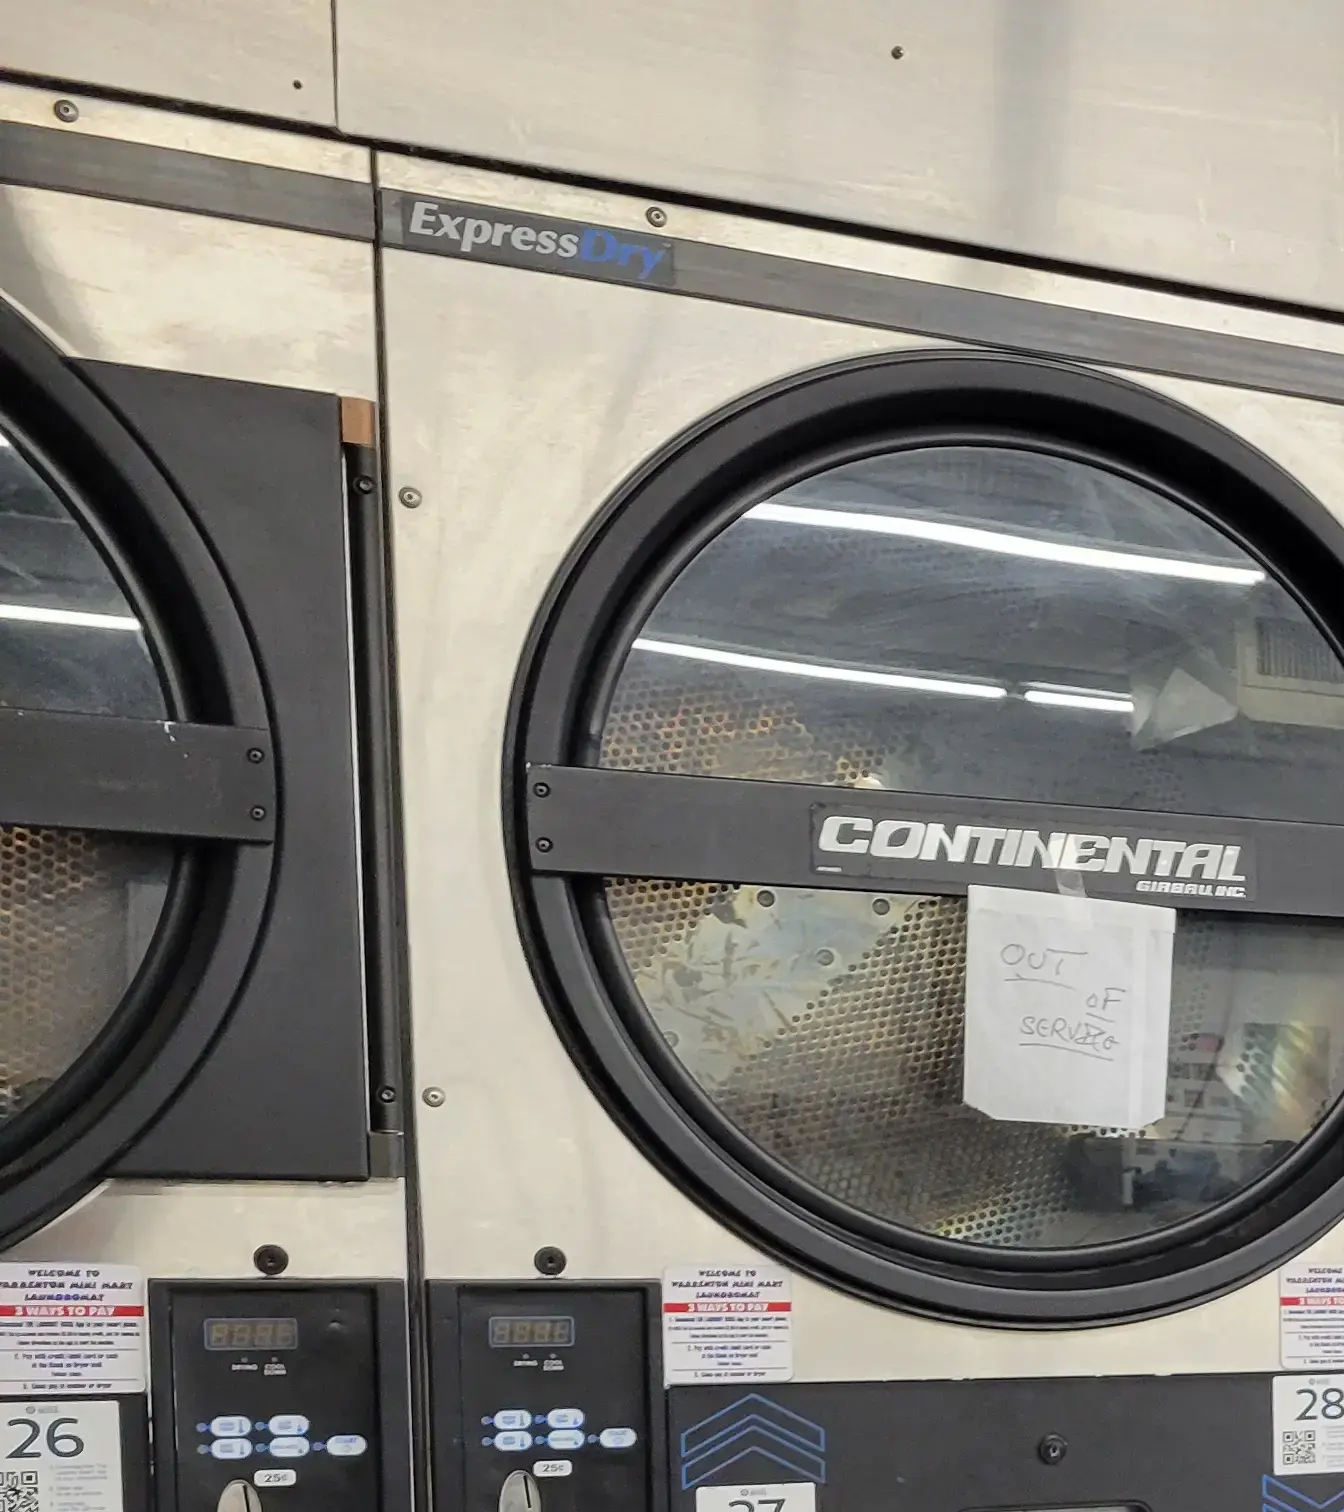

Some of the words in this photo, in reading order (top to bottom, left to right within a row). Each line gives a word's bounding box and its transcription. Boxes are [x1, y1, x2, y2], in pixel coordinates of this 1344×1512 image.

[409, 201, 666, 280] ExpressDry
[818, 815, 1246, 882] CONTINENTAL
[1000, 942, 1088, 975] OUT
[28, 1269, 80, 1277] WELCOME
[14, 1306, 23, 1316] 3
[26, 1306, 64, 1316] WAYS
[67, 1306, 86, 1316] TO
[89, 1306, 115, 1316] PAY
[697, 1303, 727, 1311] WAYS
[730, 1303, 745, 1311] TO
[747, 1303, 768, 1311] PAY
[1294, 1388, 1344, 1421] 28
[6, 1418, 84, 1459] 26
